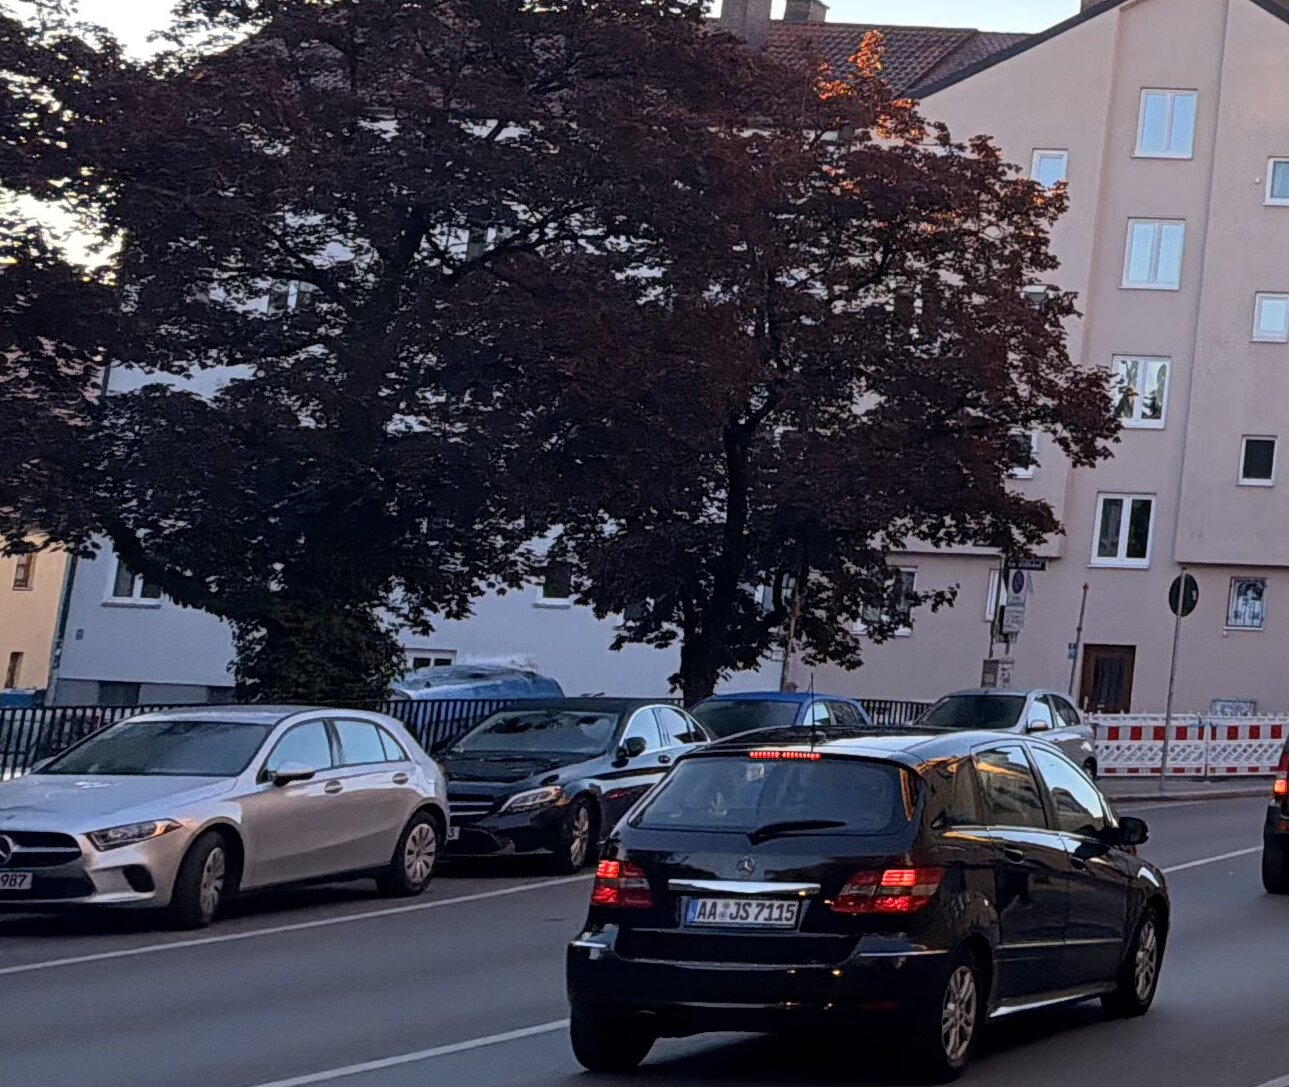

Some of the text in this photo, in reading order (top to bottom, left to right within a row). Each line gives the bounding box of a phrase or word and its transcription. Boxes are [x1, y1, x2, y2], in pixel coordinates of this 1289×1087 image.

[696, 901, 797, 922] AA JS 7115
